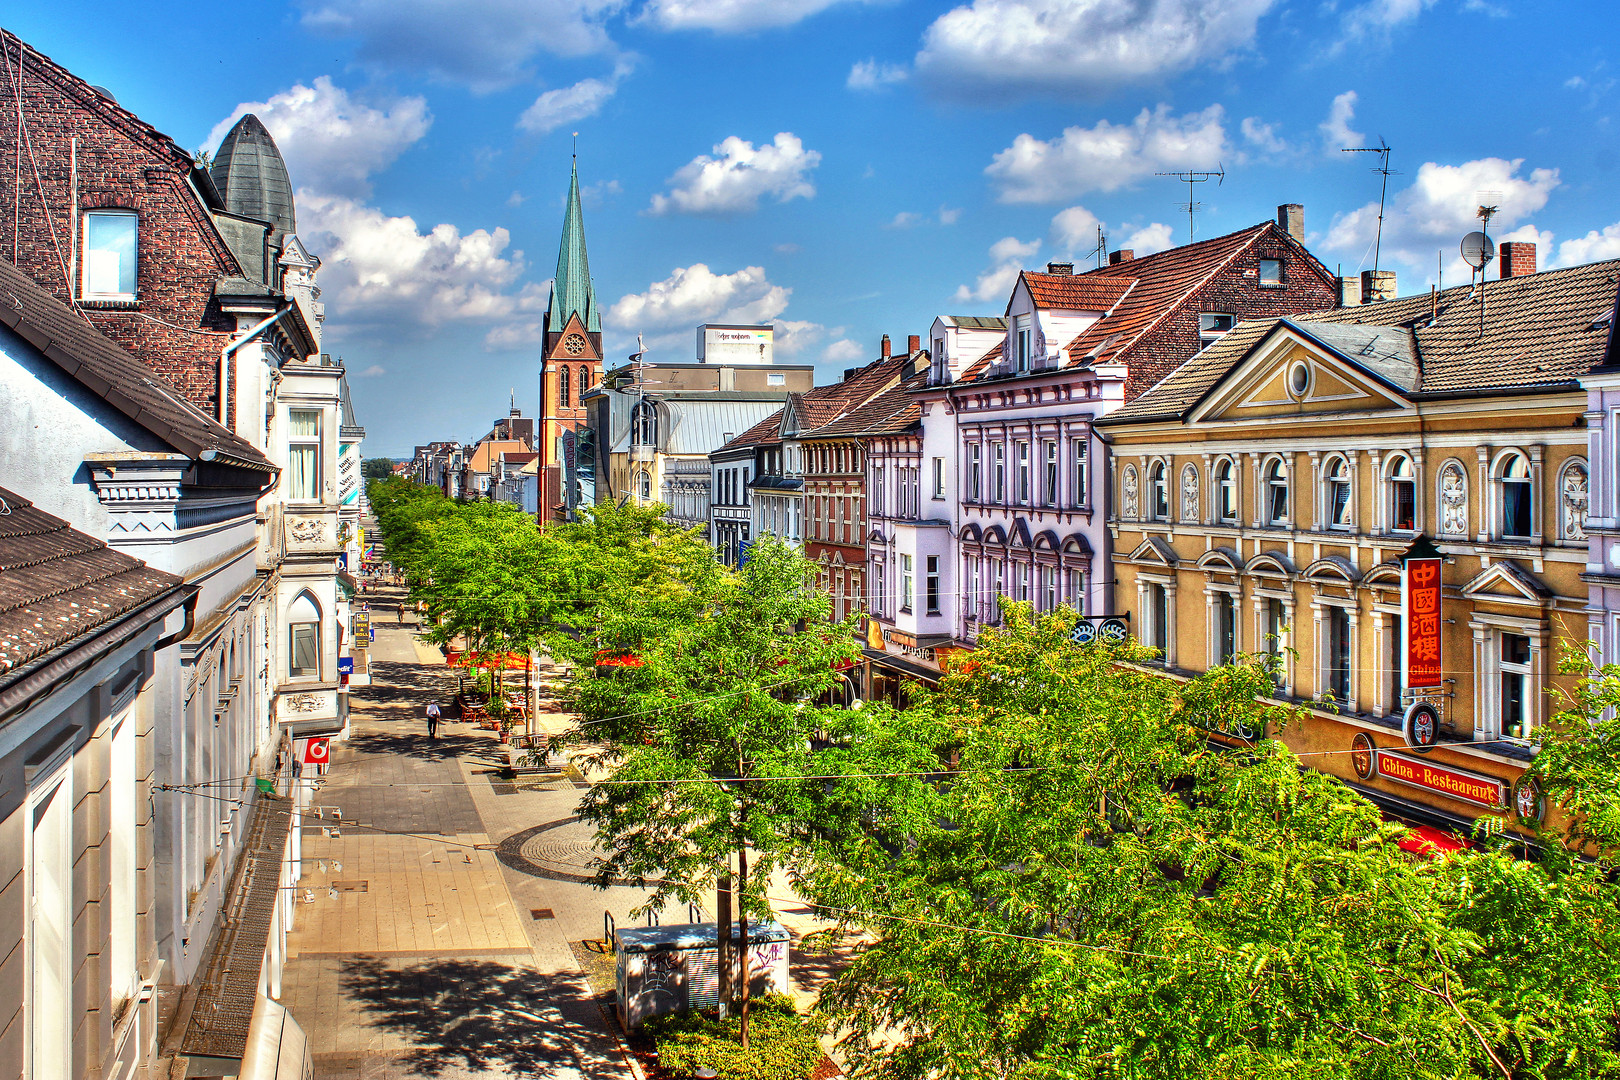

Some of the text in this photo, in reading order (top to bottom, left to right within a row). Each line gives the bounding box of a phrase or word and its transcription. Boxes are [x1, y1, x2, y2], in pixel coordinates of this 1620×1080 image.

[1410, 664, 1441, 676] China
[1382, 756, 1414, 779] China
[1423, 768, 1494, 801] Restaurant
